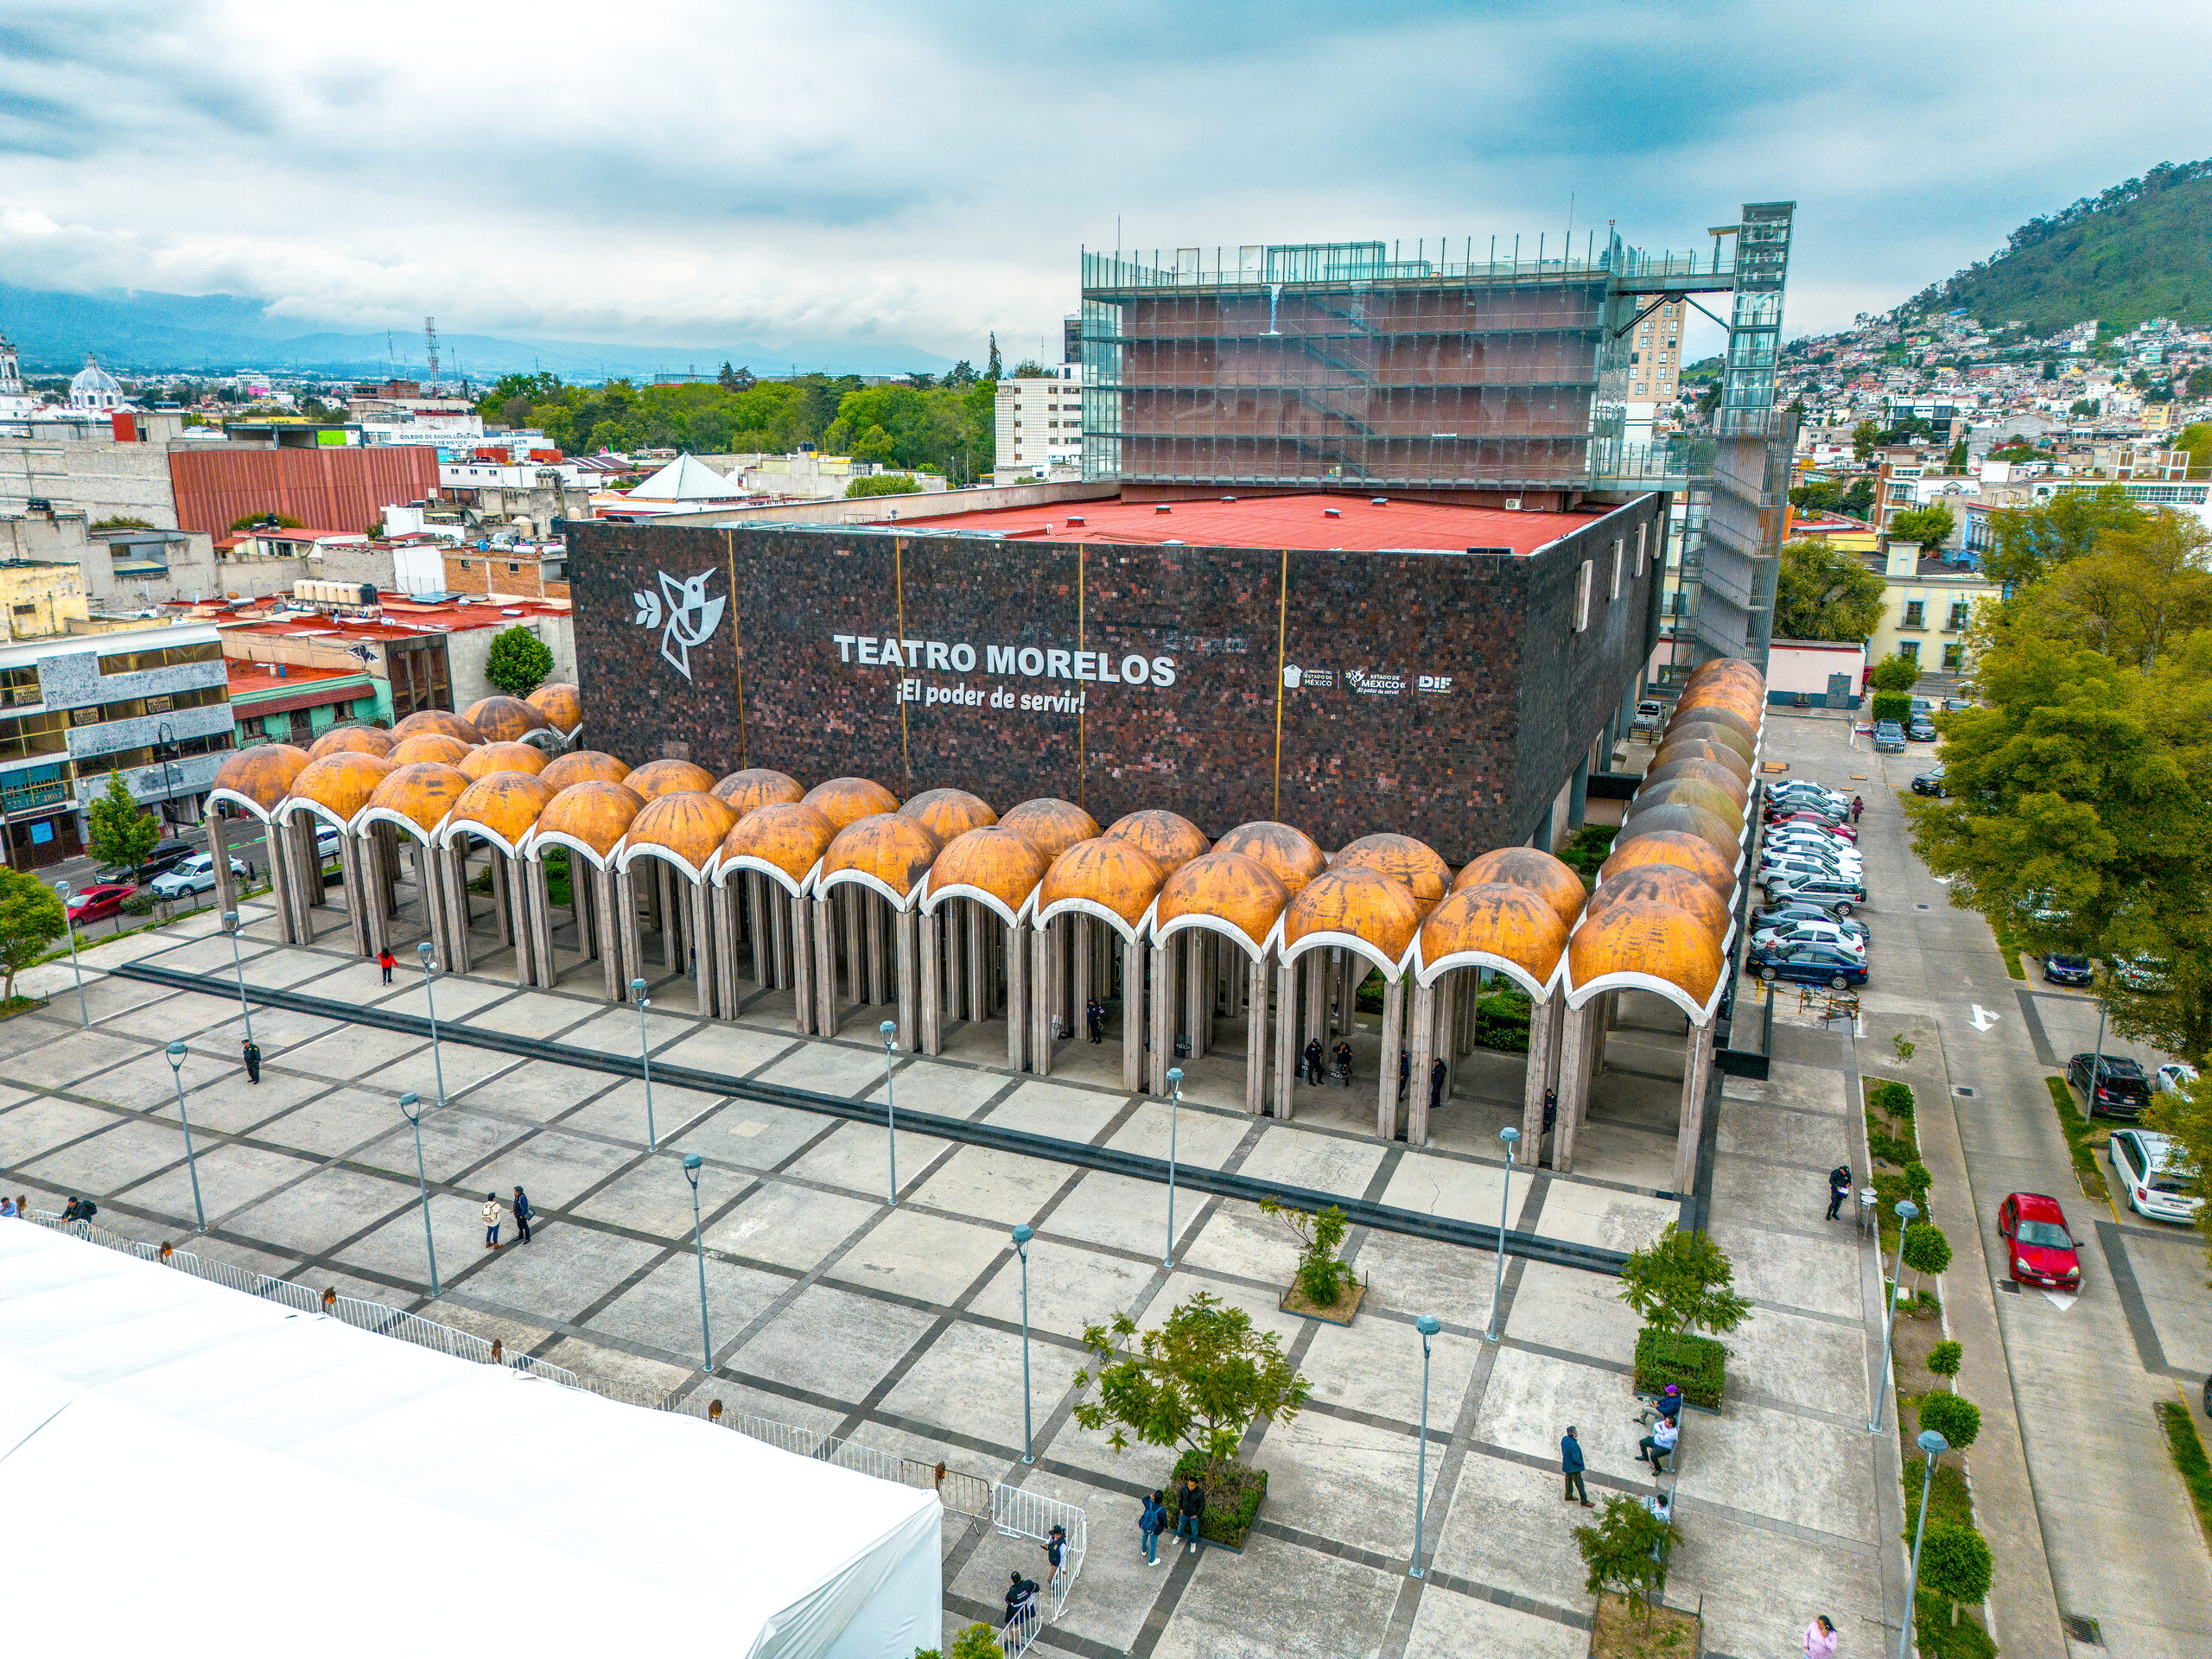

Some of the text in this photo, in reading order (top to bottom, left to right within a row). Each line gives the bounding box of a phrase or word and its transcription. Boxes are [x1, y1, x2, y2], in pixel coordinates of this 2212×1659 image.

[833, 634, 1176, 687] TEATRO MORELOS
[1304, 678, 1332, 686] MÉXICO
[1361, 679, 1399, 689] MÉXICO
[1419, 676, 1452, 689] DIF
[896, 678, 1086, 714] ¡El poder de servir!
[4, 777, 61, 798] SE VENDE
